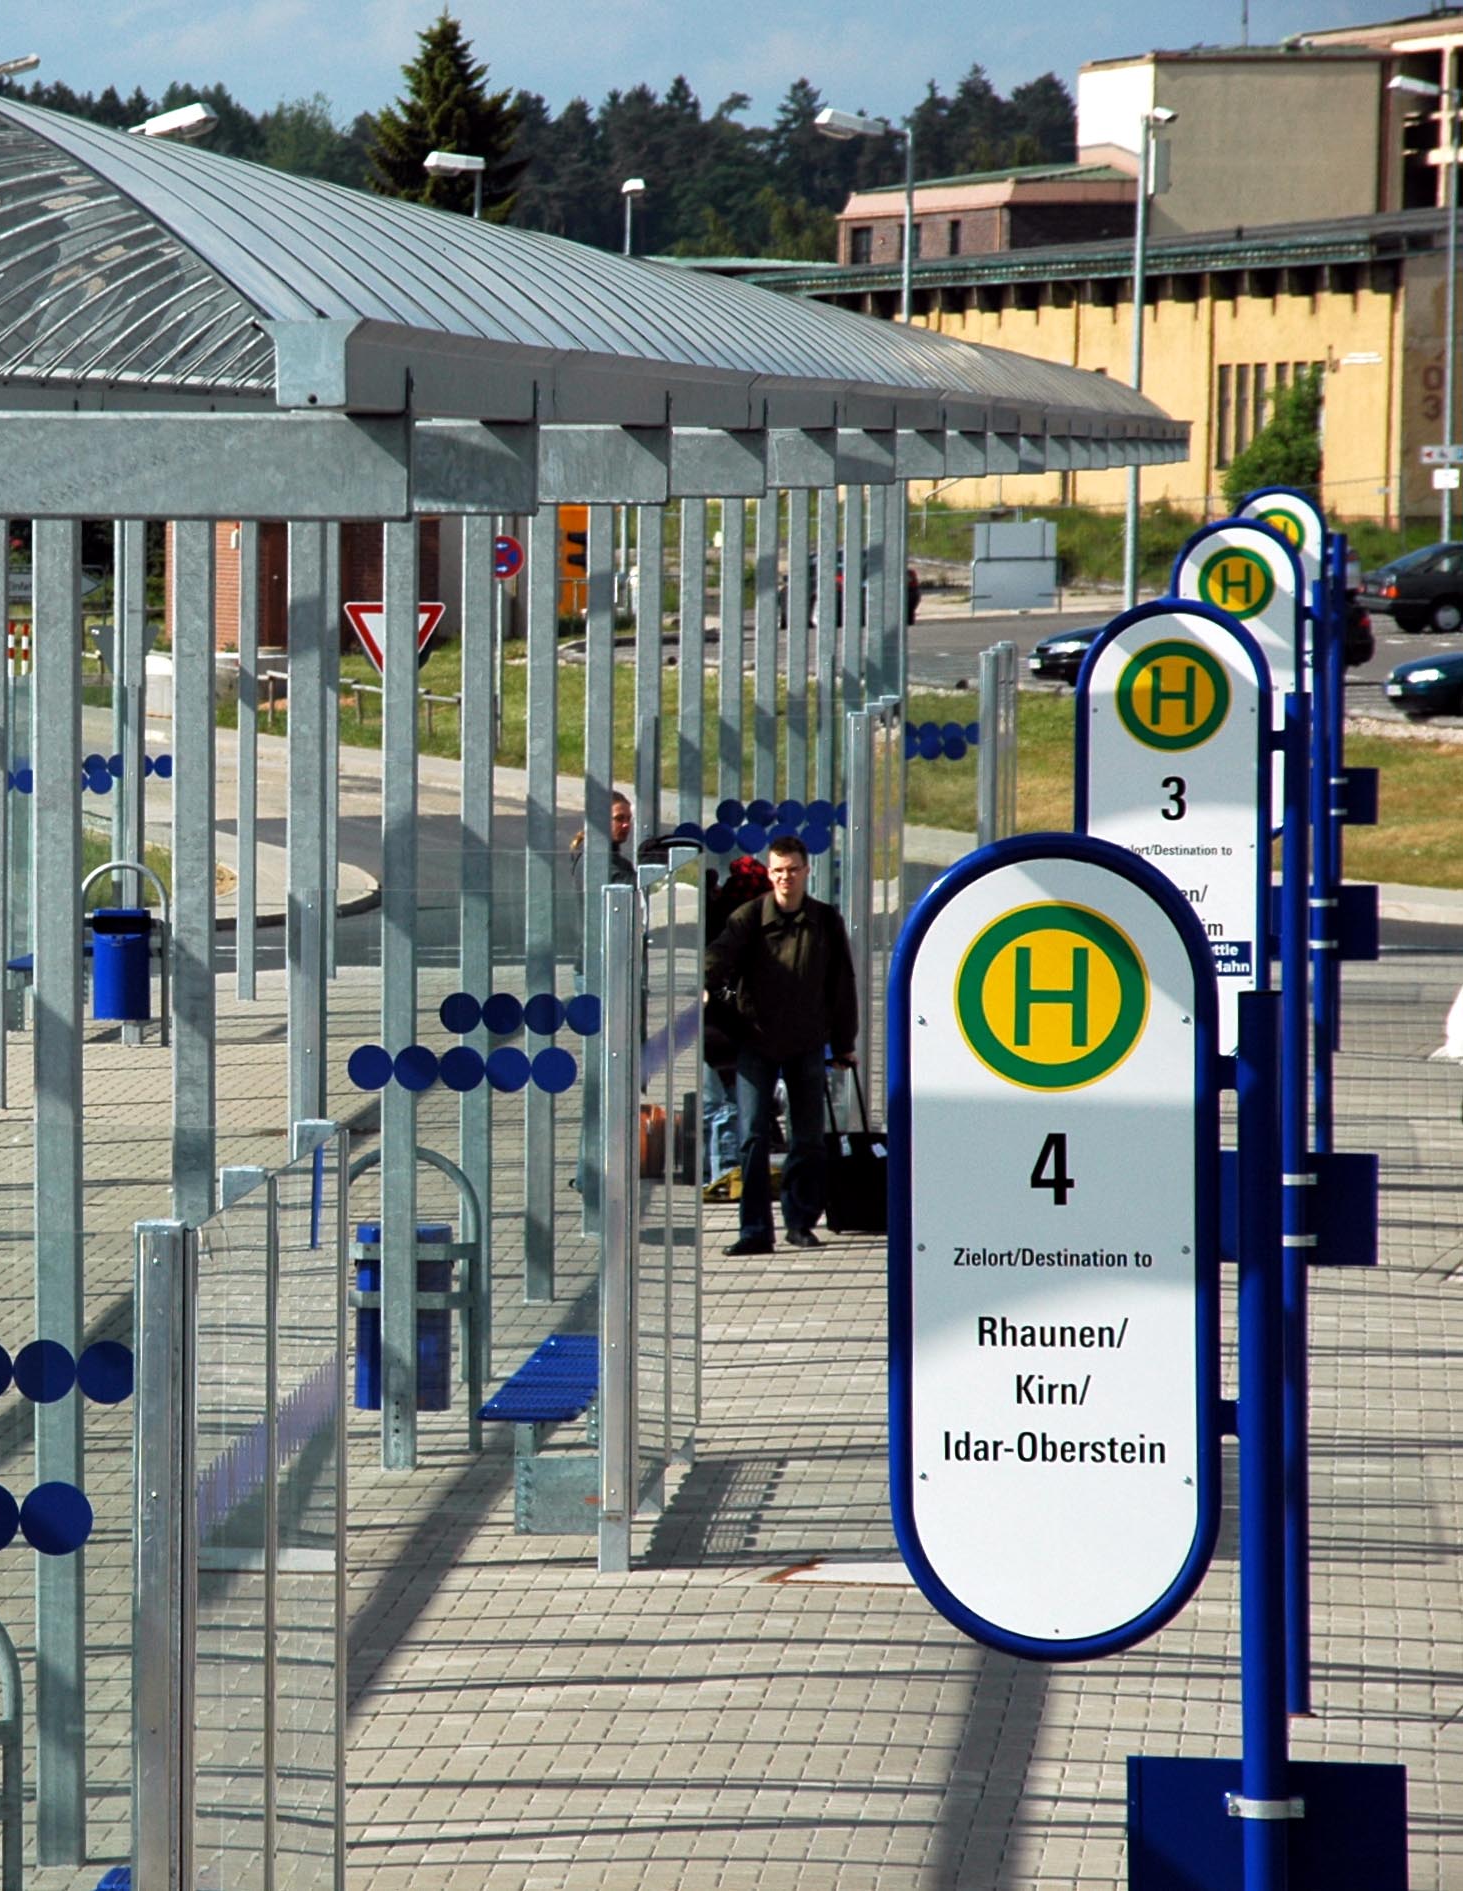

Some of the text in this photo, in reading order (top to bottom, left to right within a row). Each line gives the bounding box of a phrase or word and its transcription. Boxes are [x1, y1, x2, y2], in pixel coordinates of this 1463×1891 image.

[1150, 666, 1197, 726] H
[1160, 775, 1188, 821] 3
[1130, 844, 1233, 856] lort/Destination to
[1211, 944, 1239, 956] ttle
[1012, 945, 1090, 1048] H
[1030, 1132, 1075, 1206] 4
[953, 1247, 1153, 1268] Zielort/Destination to
[978, 1316, 1129, 1349] Rhaunen/
[1015, 1374, 1092, 1406] Kirn/
[943, 1430, 1166, 1464] Idar-Oberstein
